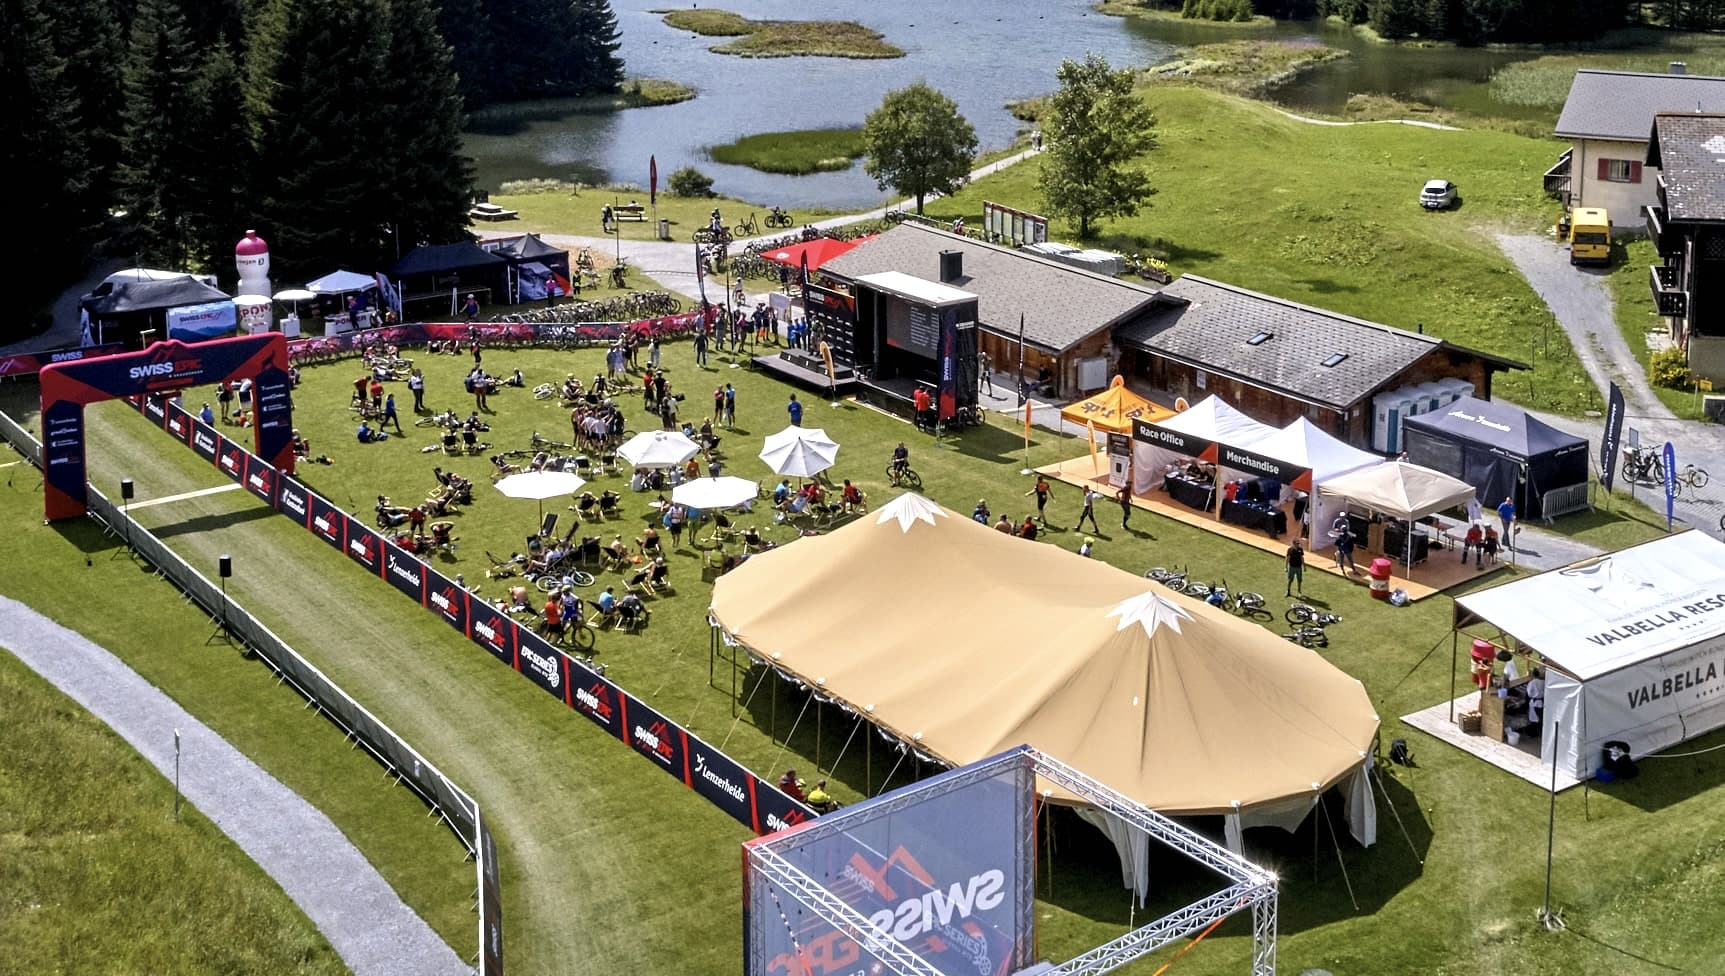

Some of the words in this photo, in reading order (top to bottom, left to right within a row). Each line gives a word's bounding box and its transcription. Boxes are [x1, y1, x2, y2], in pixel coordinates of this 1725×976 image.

[52, 351, 82, 362] SWISS
[130, 362, 174, 378] SWISS
[1140, 425, 1159, 441] Race
[1160, 430, 1184, 447] Office
[1227, 450, 1279, 475] Merchandise
[1586, 610, 1688, 646] VALBELLA
[1628, 661, 1717, 709] VALBELLA
[577, 688, 599, 710] SWISS
[635, 725, 659, 748] SWISS
[702, 765, 745, 802] Lenzerheide
